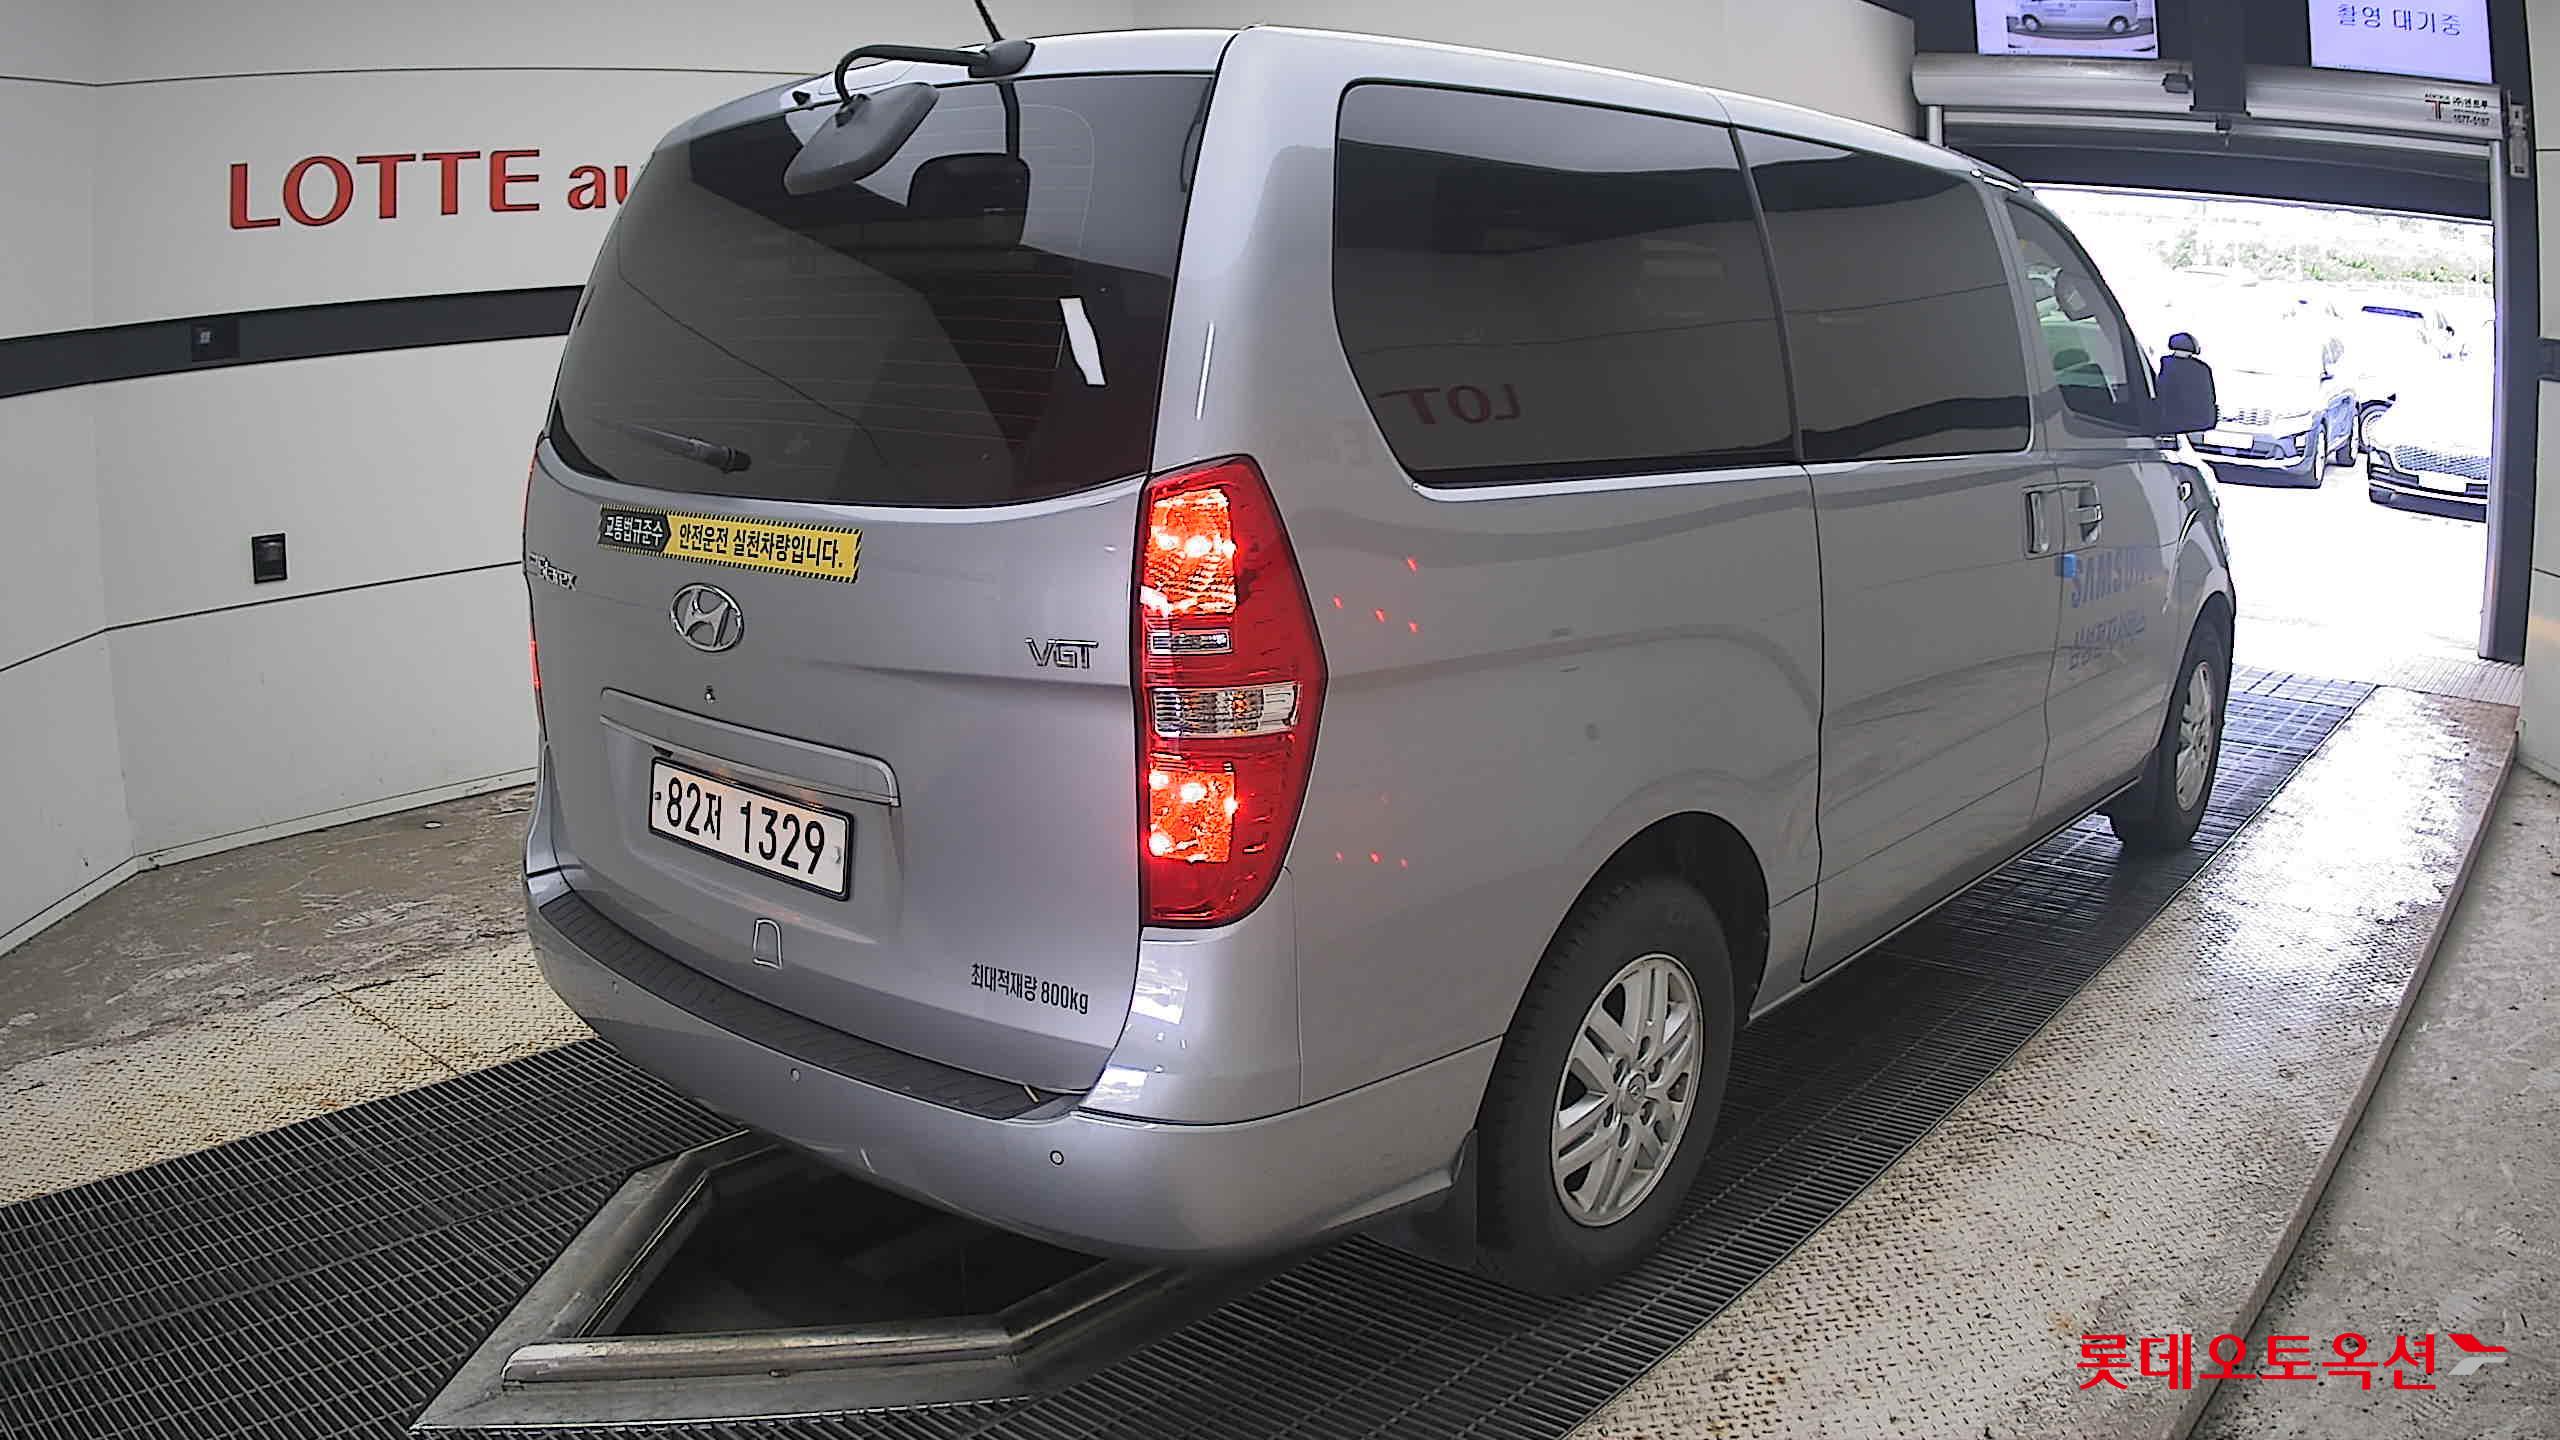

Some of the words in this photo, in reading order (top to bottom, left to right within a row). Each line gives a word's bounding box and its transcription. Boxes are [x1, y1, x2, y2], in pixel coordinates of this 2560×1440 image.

[2392, 8, 2462, 37] 대기중
[228, 149, 541, 230] LOTTE
[603, 515, 664, 547] 교통법규준수
[679, 522, 730, 555] 안전운전
[732, 528, 845, 570] 실천차량입니다.
[2069, 547, 2156, 609] SAMSU
[1024, 636, 1101, 669] VGT
[666, 776, 724, 841] 82저
[740, 799, 827, 876] 1329
[970, 962, 1038, 1002] 최대적재량
[1040, 980, 1090, 1015] 800kg
